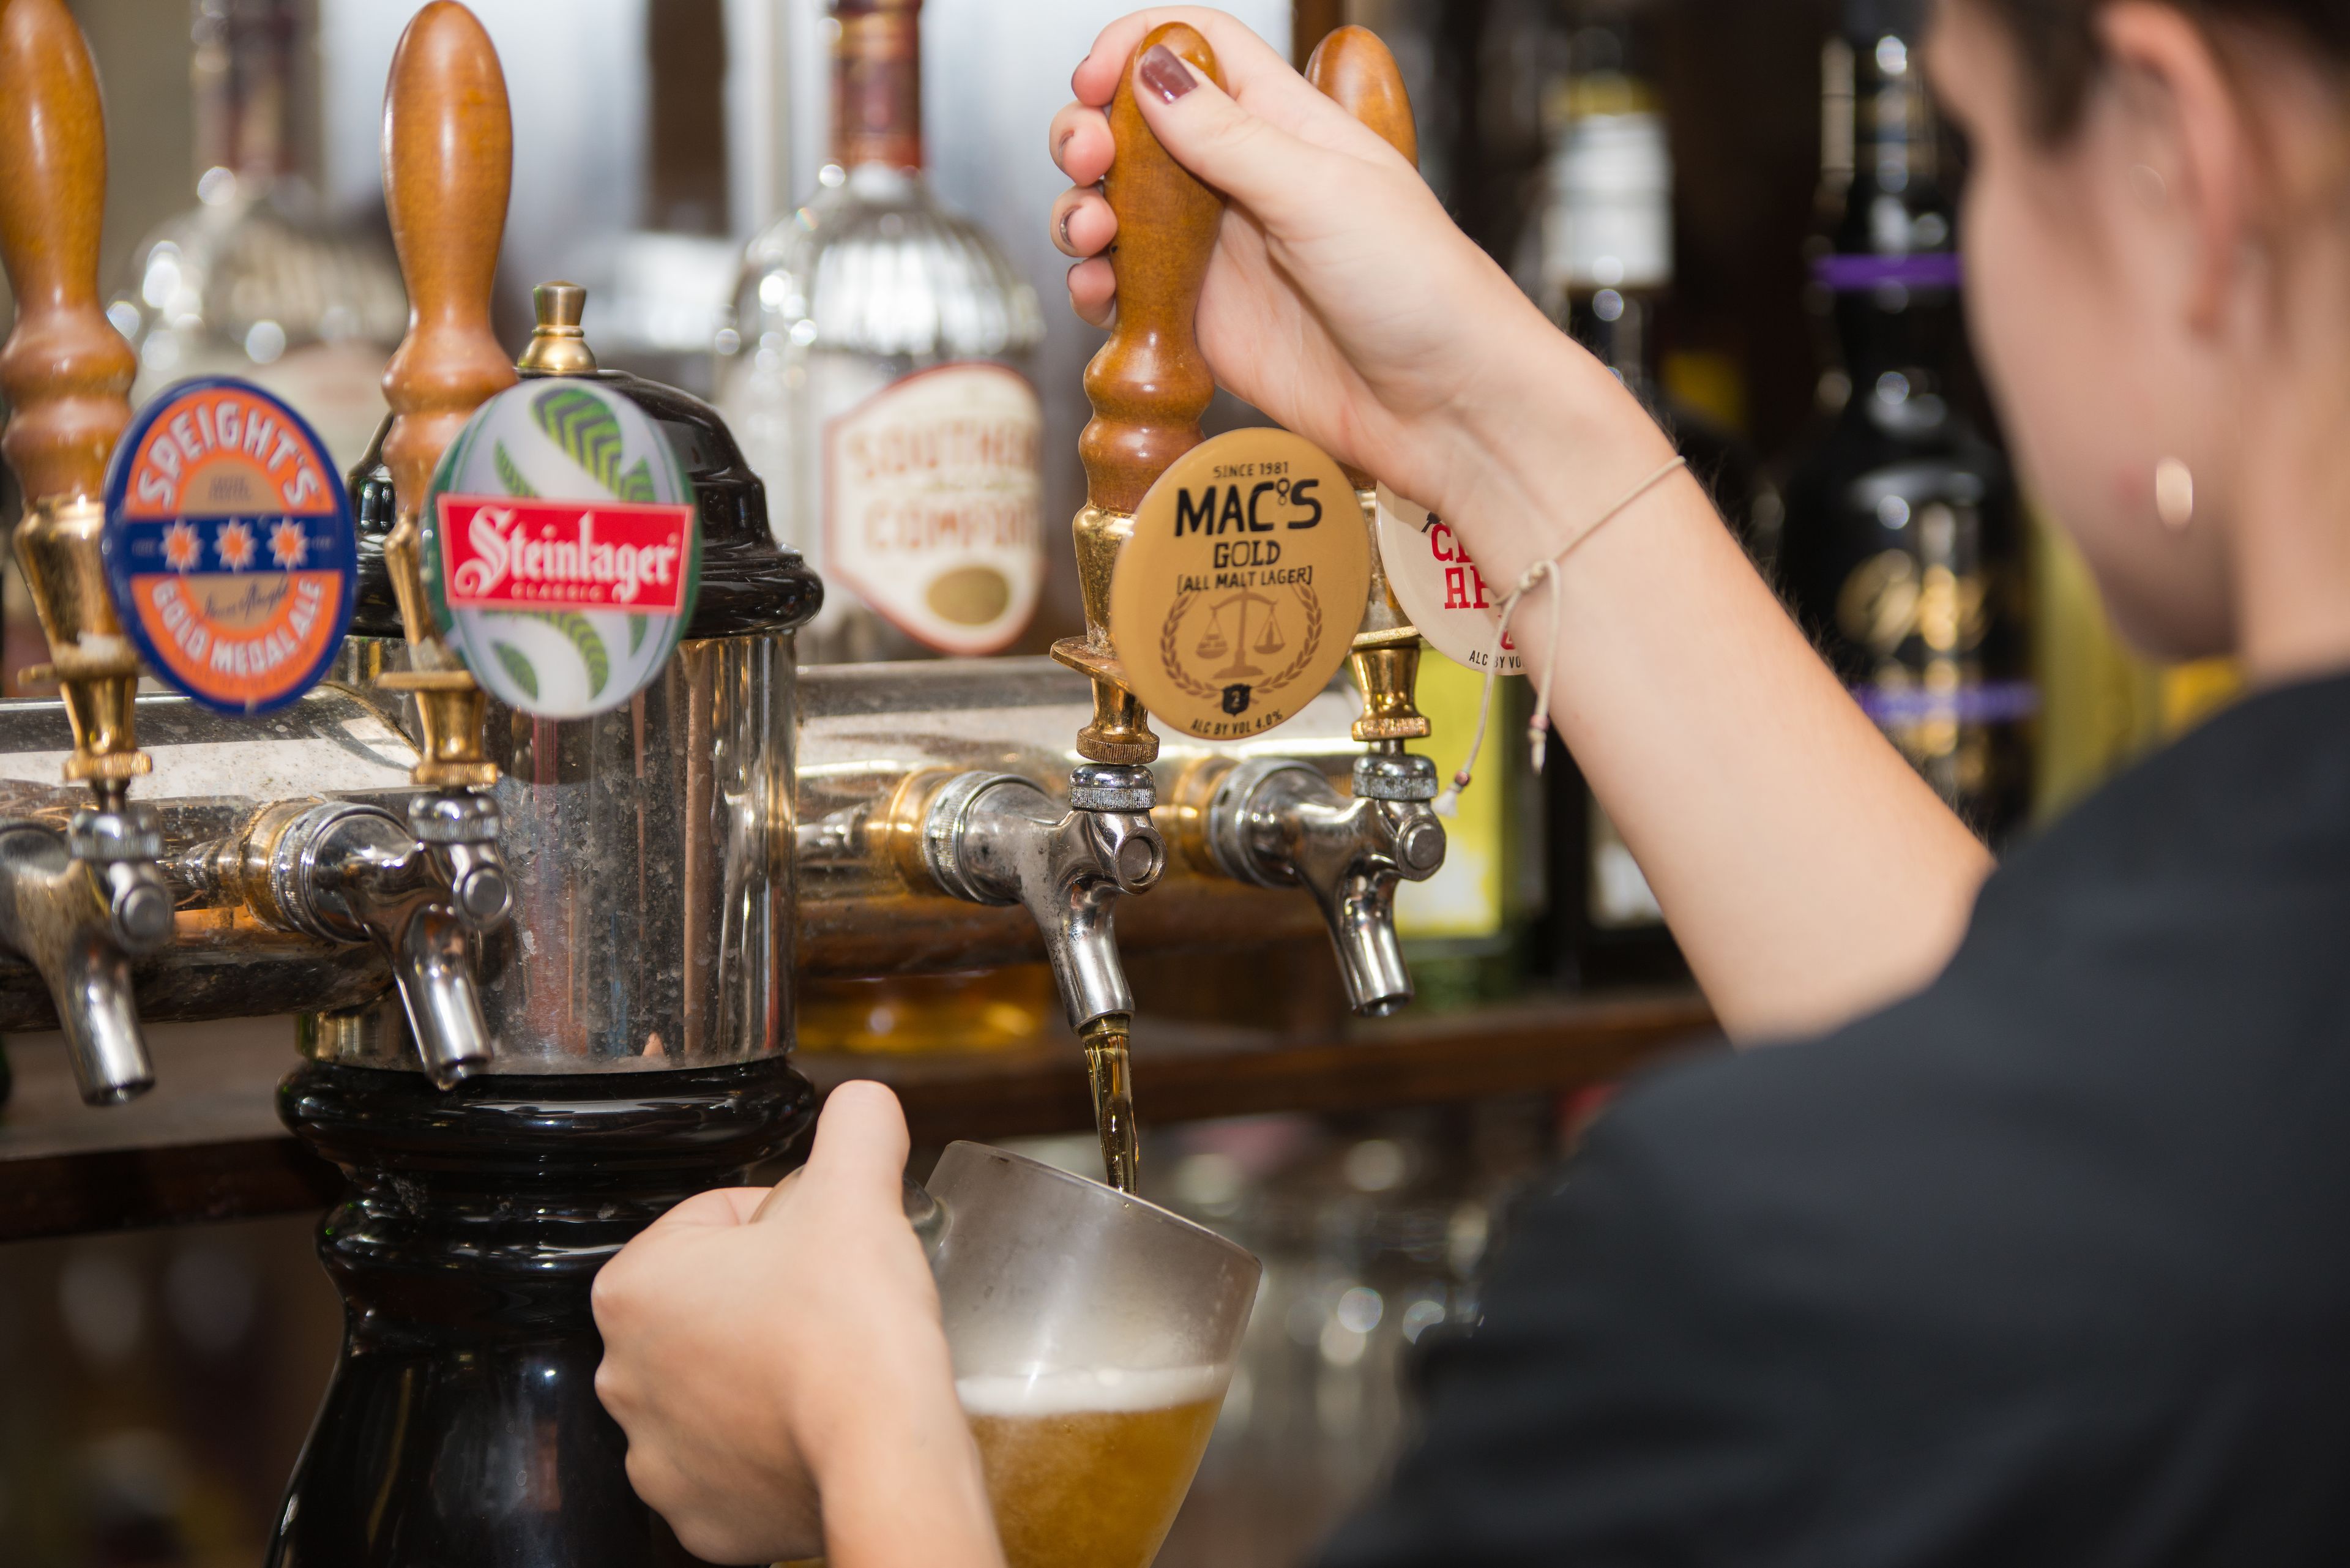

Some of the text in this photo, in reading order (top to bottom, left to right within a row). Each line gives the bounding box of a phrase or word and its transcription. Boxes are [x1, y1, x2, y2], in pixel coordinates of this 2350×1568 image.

[137, 401, 319, 509] SPEIGHT'S
[1214, 461, 1288, 479] SINCE 1981
[1174, 477, 1322, 537] MAC'S
[454, 506, 677, 603] Steinlager
[1213, 540, 1281, 569] GOLD
[510, 582, 606, 603] CLASSIC
[1215, 571, 1256, 589] MALT
[151, 578, 211, 662] GOLD
[210, 627, 299, 676] MEDAL
[288, 577, 322, 641] ALE
[1469, 650, 1488, 666] ALC
[1509, 655, 1524, 669] VO
[1190, 709, 1283, 735] ALC BY VOL 4.0%
